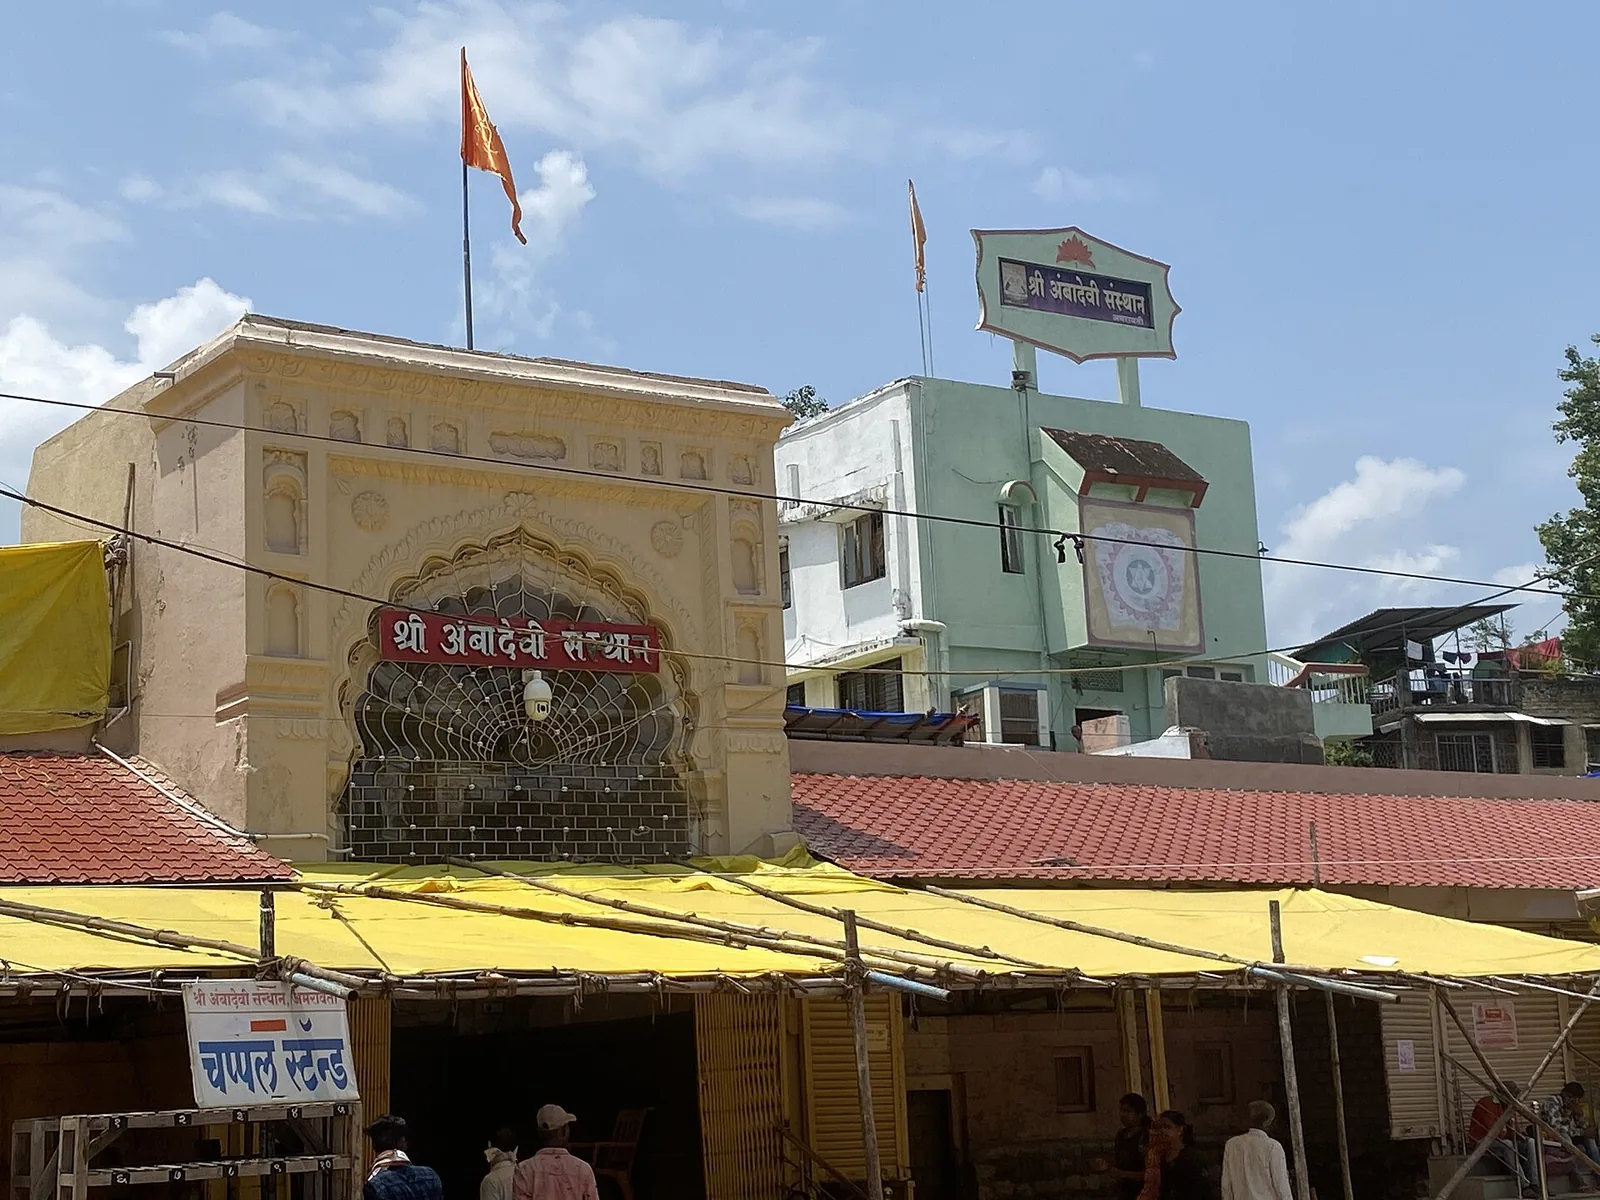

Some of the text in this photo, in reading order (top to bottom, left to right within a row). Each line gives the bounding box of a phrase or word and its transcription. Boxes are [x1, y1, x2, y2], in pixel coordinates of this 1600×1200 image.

[1028, 269, 1146, 315] श्री अंबादेवी संस्थान
[393, 613, 429, 654] श्री
[440, 617, 549, 662] अंबादेवी
[193, 987, 206, 1006] श्री
[198, 1040, 278, 1095] चप्पल
